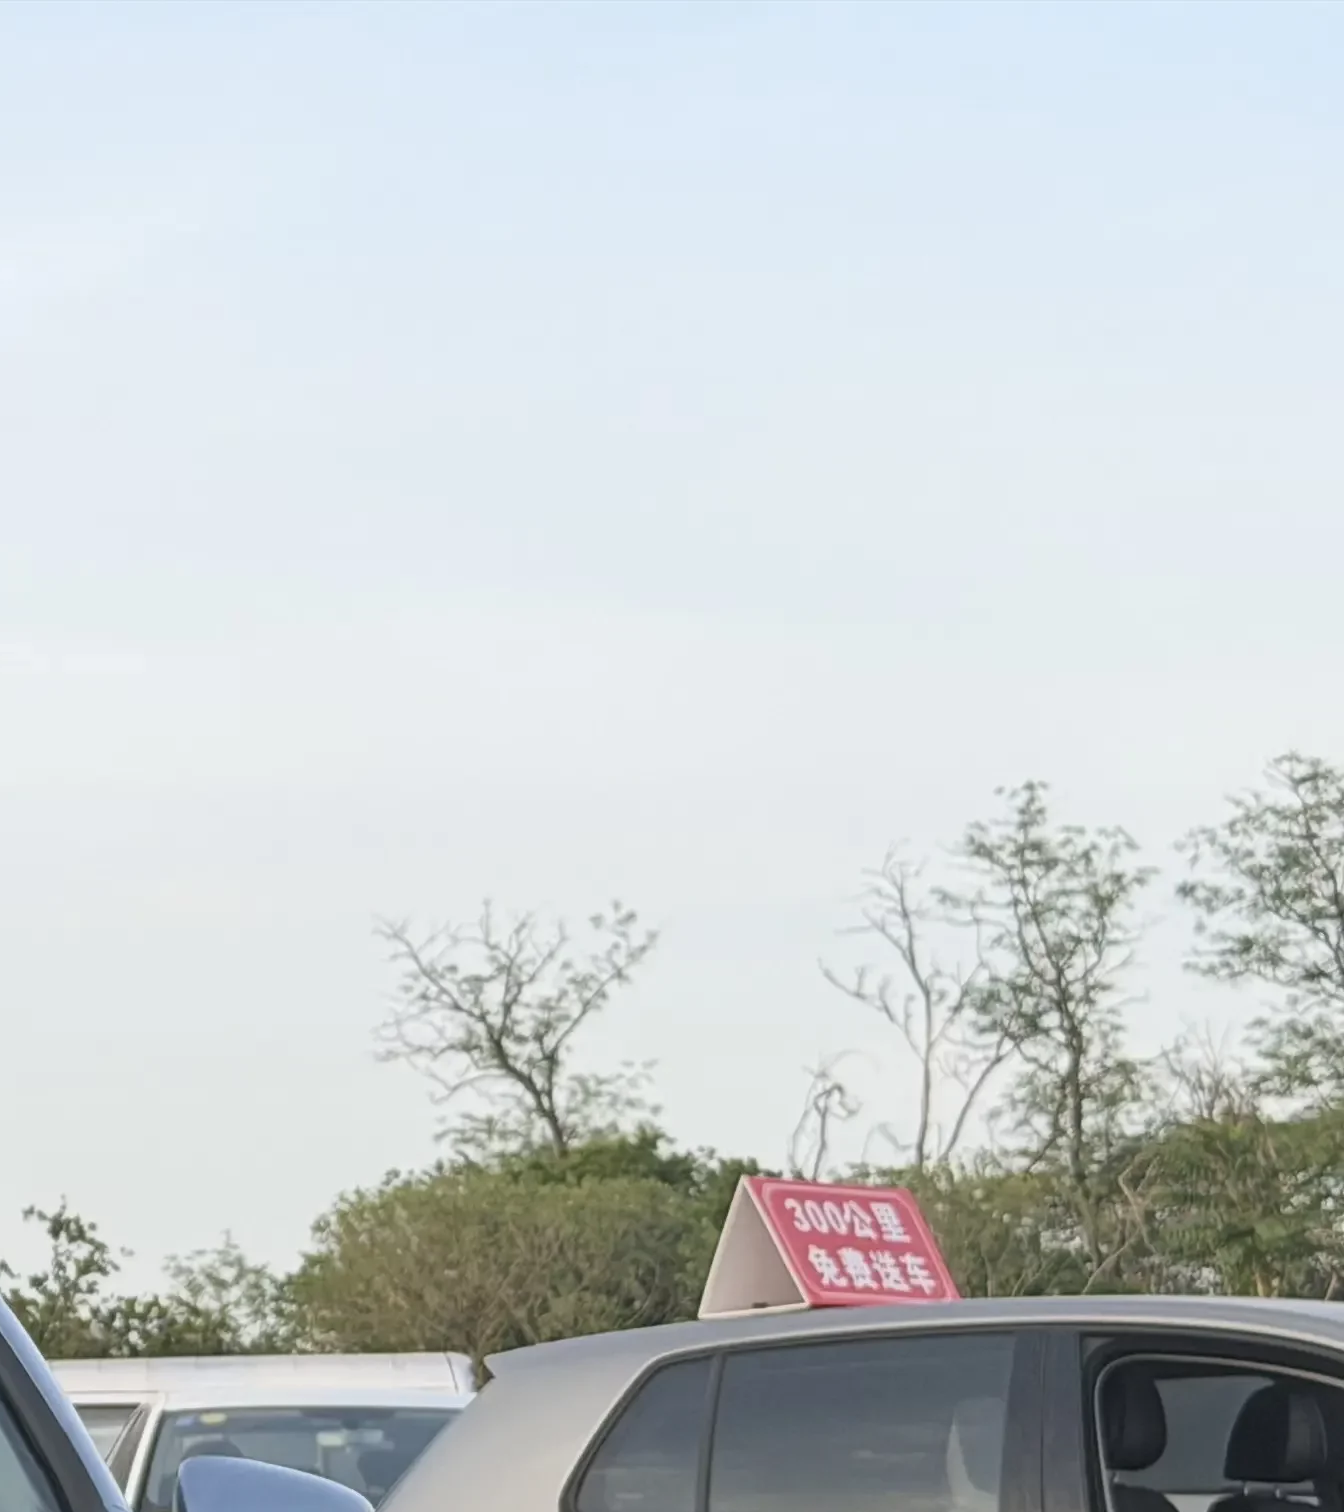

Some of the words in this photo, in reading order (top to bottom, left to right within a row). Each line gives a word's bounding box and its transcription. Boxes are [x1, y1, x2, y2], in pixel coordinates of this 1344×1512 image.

[783, 1197, 911, 1244] 300公里
[807, 1243, 937, 1295] 免费送车
